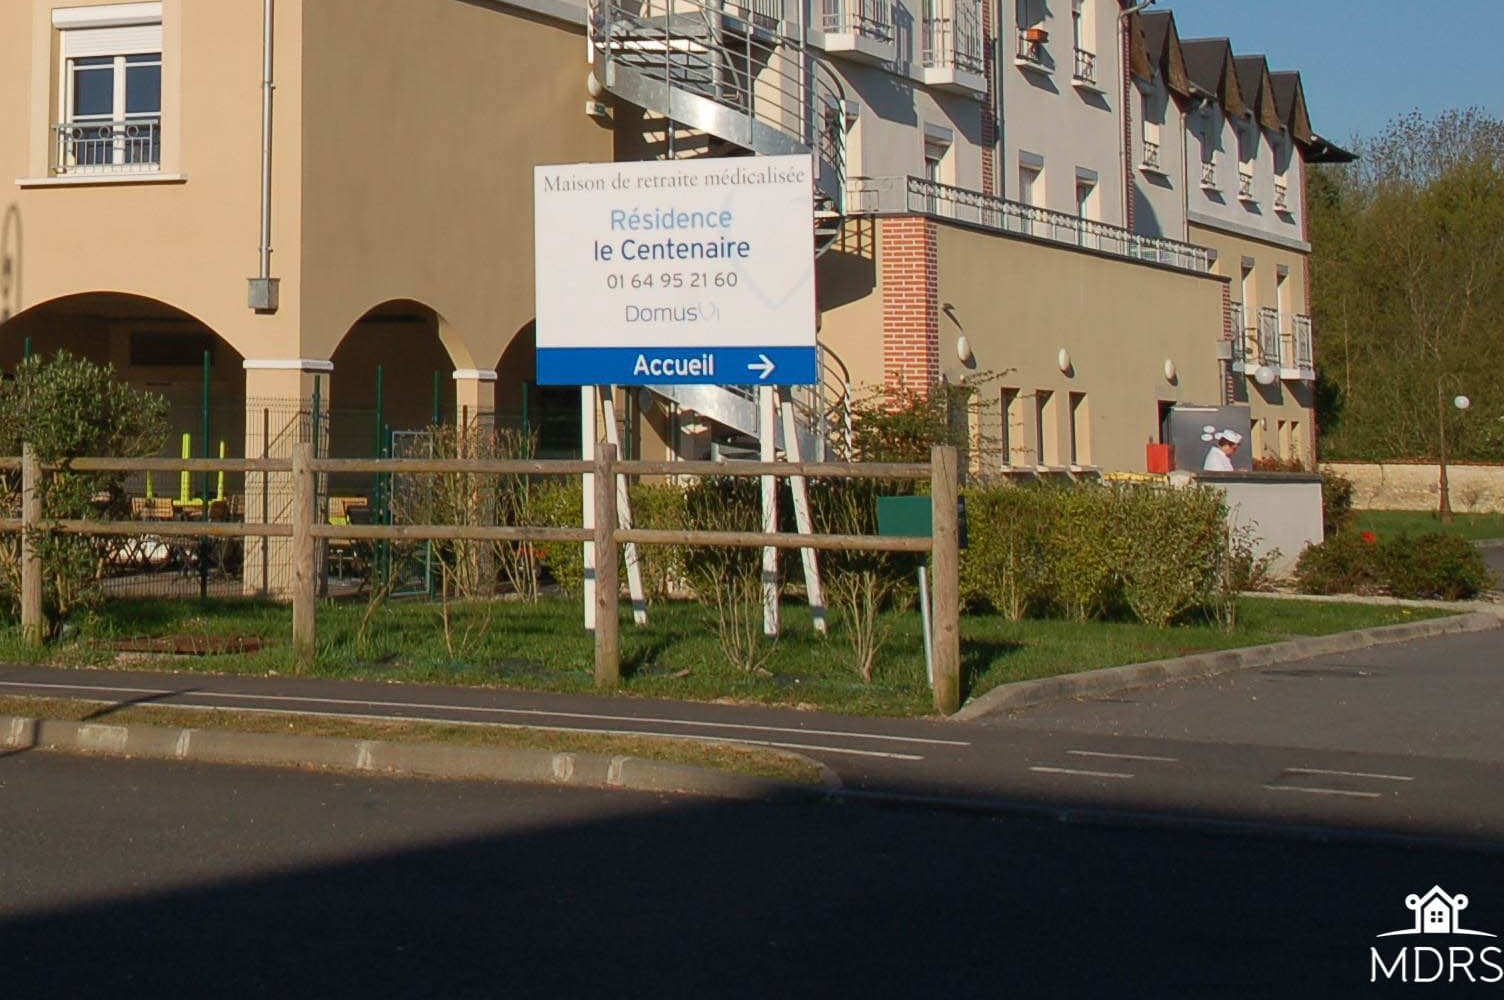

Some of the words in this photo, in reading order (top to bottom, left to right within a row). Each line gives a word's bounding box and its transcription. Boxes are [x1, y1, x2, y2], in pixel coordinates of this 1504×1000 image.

[544, 174, 605, 192] Maison
[612, 172, 630, 190] de
[637, 174, 698, 189] retraite
[704, 166, 805, 186] médicalisée
[610, 208, 733, 231] Résidence
[594, 239, 614, 261] le
[620, 236, 751, 261] Centenaire
[607, 273, 624, 289] 01
[631, 273, 653, 289] 64
[660, 272, 683, 288] 95
[690, 272, 707, 288] 21
[714, 271, 738, 288] 60
[633, 353, 715, 376] Accueil
